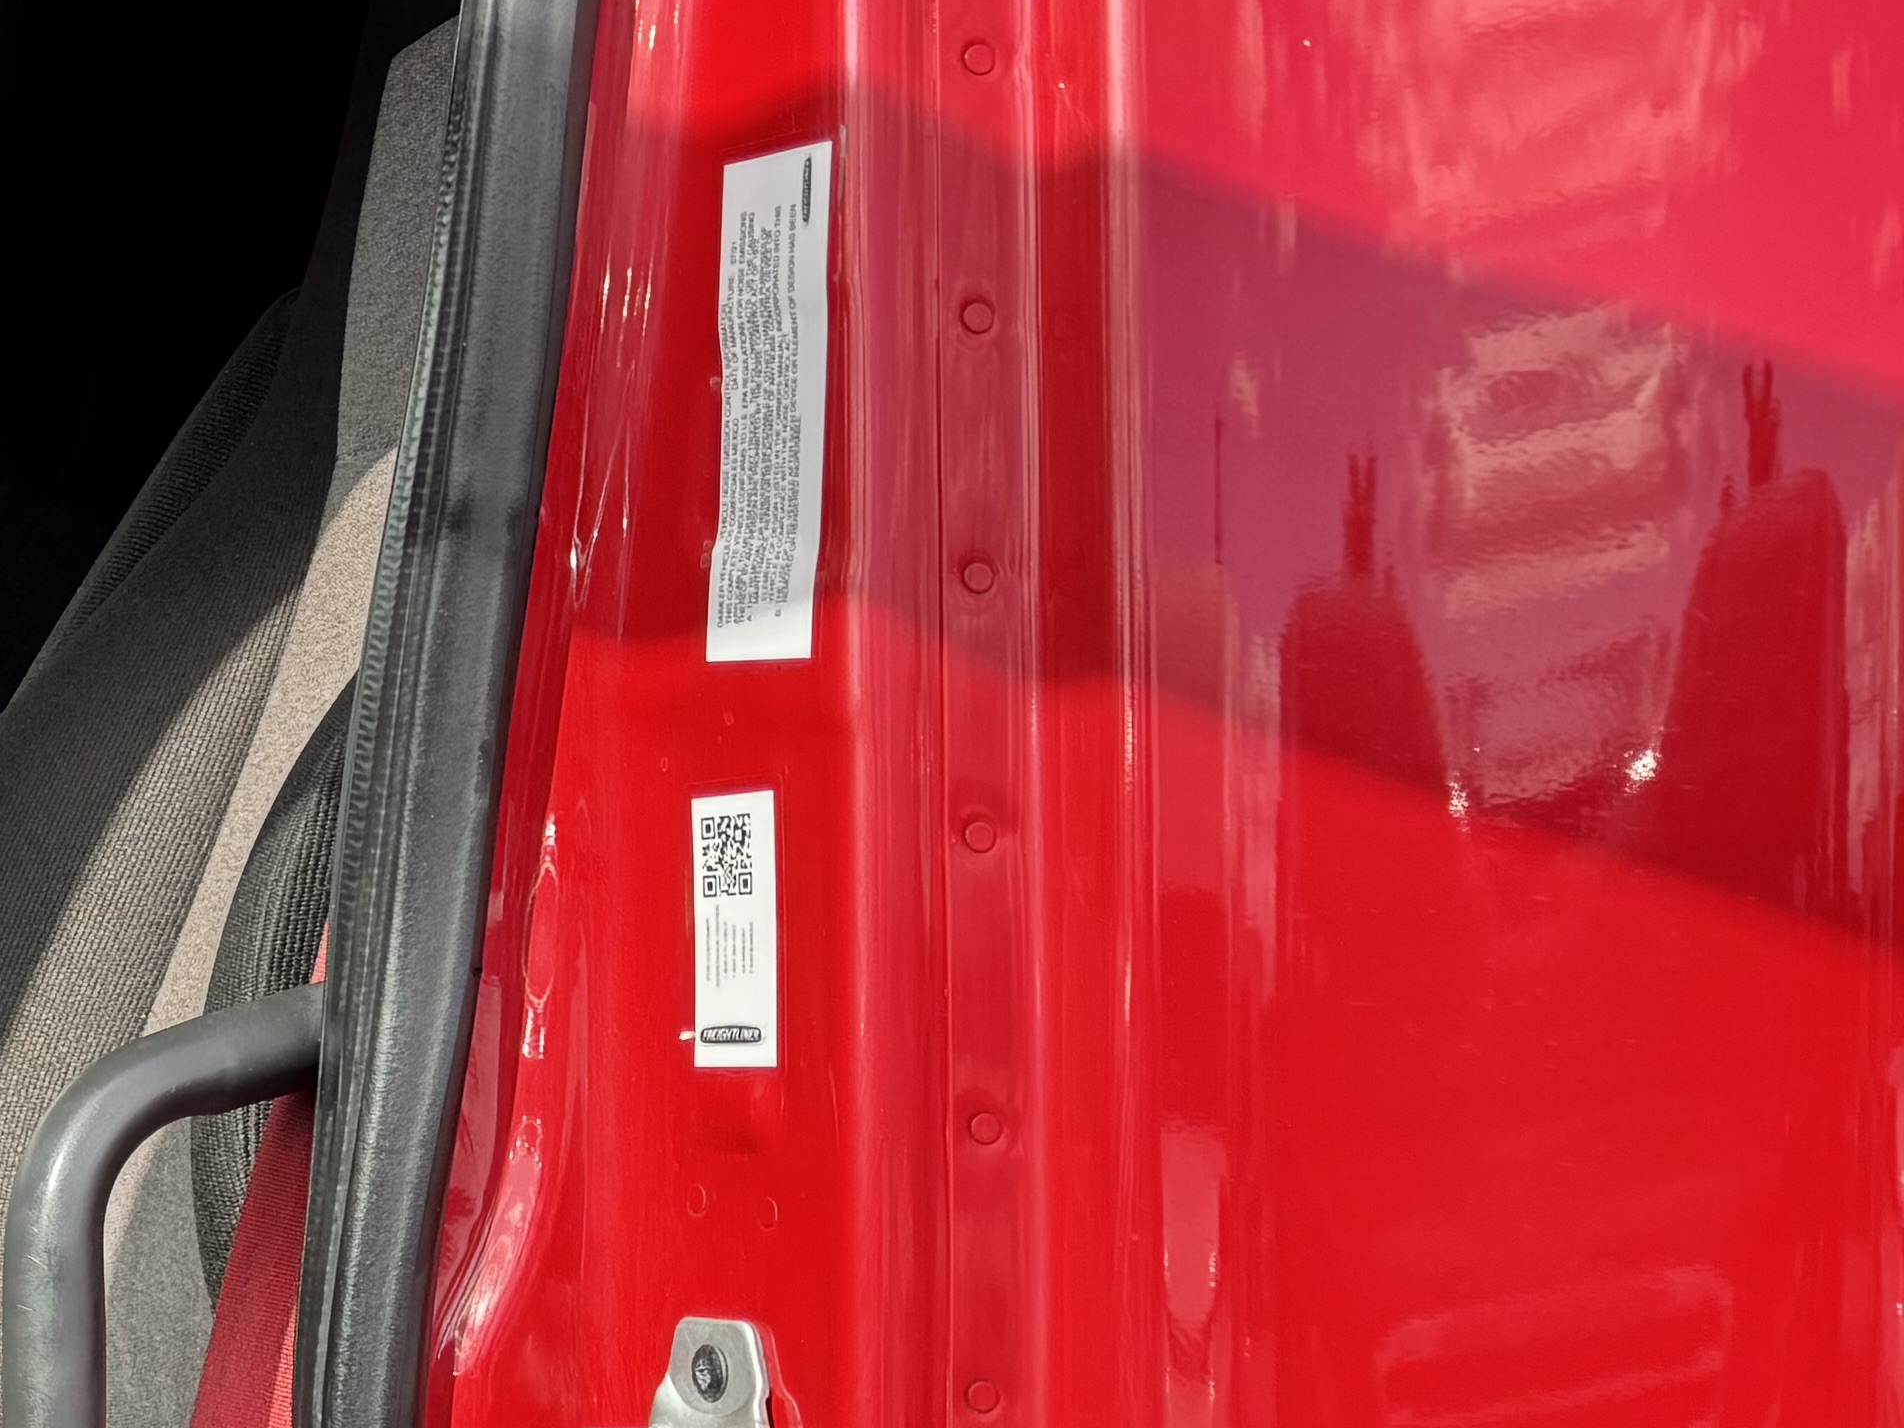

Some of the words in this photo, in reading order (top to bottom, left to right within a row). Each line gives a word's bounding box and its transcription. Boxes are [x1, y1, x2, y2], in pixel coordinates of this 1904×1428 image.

[789, 204, 797, 231] BEEN
[788, 296, 796, 309] OF
[790, 311, 798, 357] ELEMENT
[731, 351, 738, 363] OF
[738, 322, 748, 389] REGULATIONS
[791, 361, 798, 374] OR
[731, 418, 739, 456] MEXICO
[740, 433, 747, 445] TO
[729, 458, 737, 527] COMERCIALES
[733, 507, 745, 546] VEHICLE
[726, 549, 740, 601] COMPLETE
